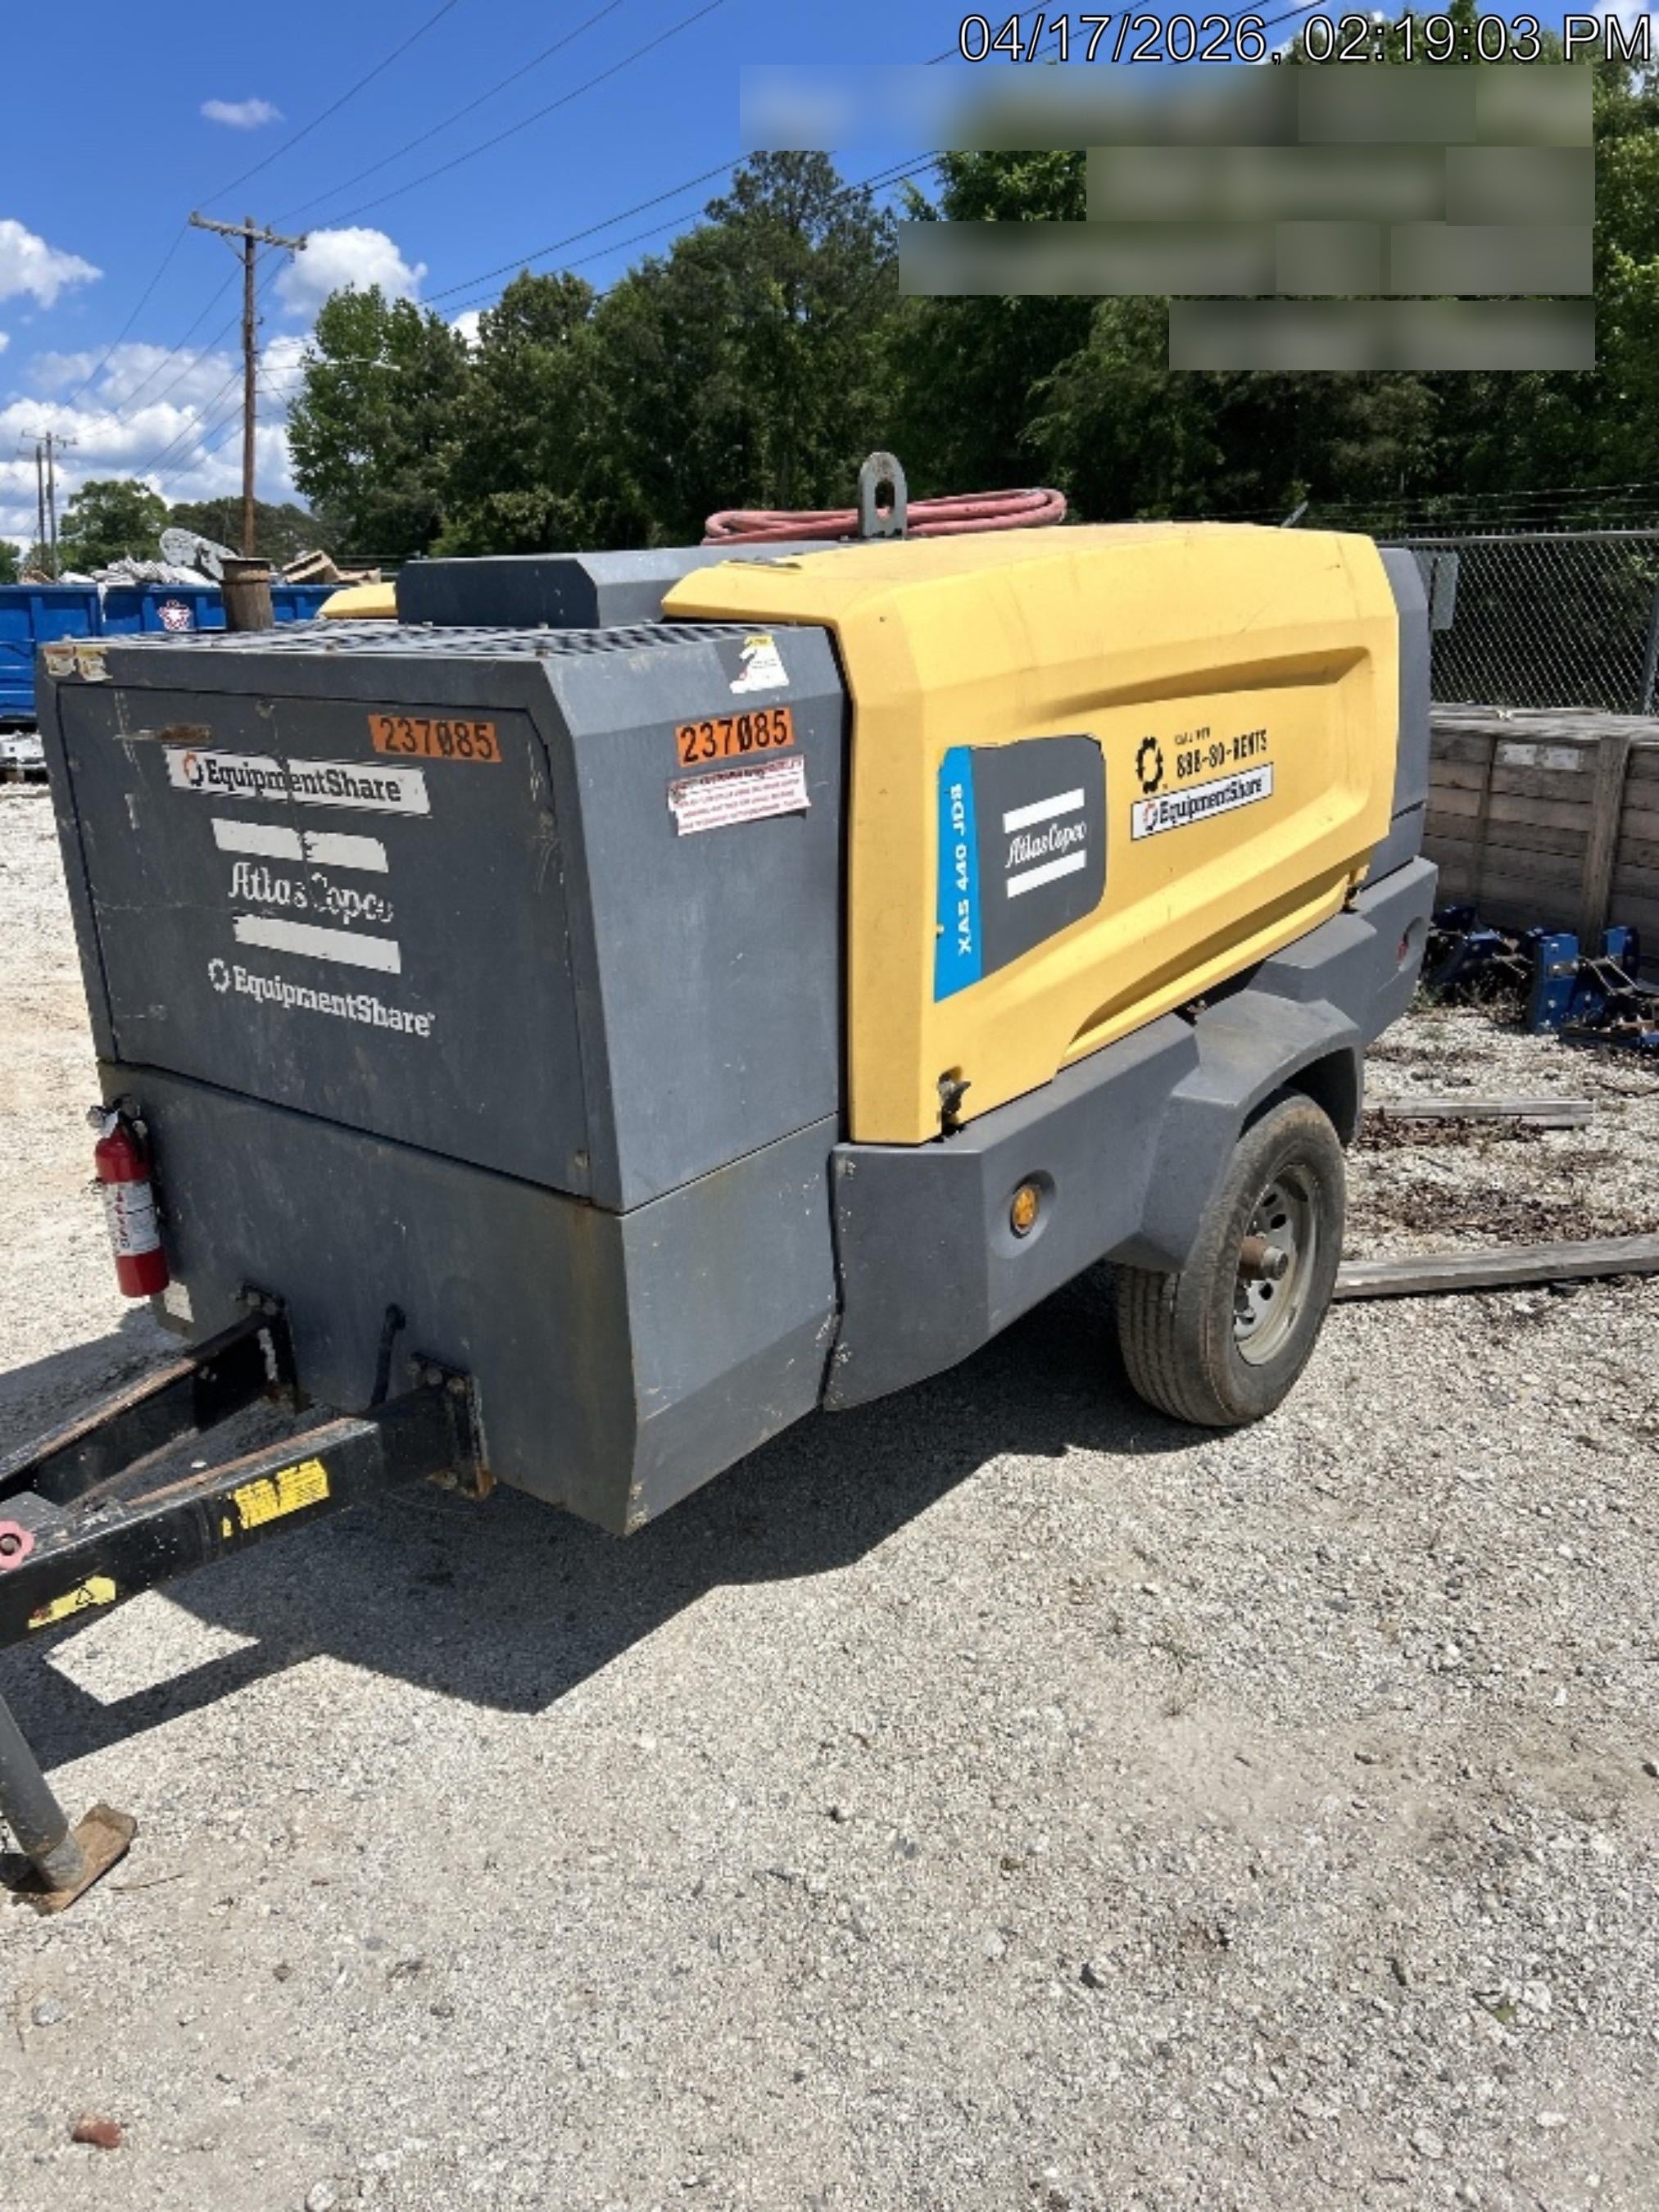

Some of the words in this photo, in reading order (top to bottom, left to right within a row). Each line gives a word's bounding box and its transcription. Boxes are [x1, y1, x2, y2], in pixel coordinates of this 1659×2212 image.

[380, 718, 492, 760] 237085
[680, 709, 787, 763] 237085
[205, 759, 401, 801] EquipmentShare
[1159, 777, 1262, 824] EquipmentShare
[954, 843, 969, 891] 440
[1004, 832, 1049, 868] Atlas
[1048, 820, 1088, 854] Copco
[228, 861, 308, 909] Atlas
[957, 899, 972, 957] XAS
[232, 965, 431, 1038] EquipmentShare
